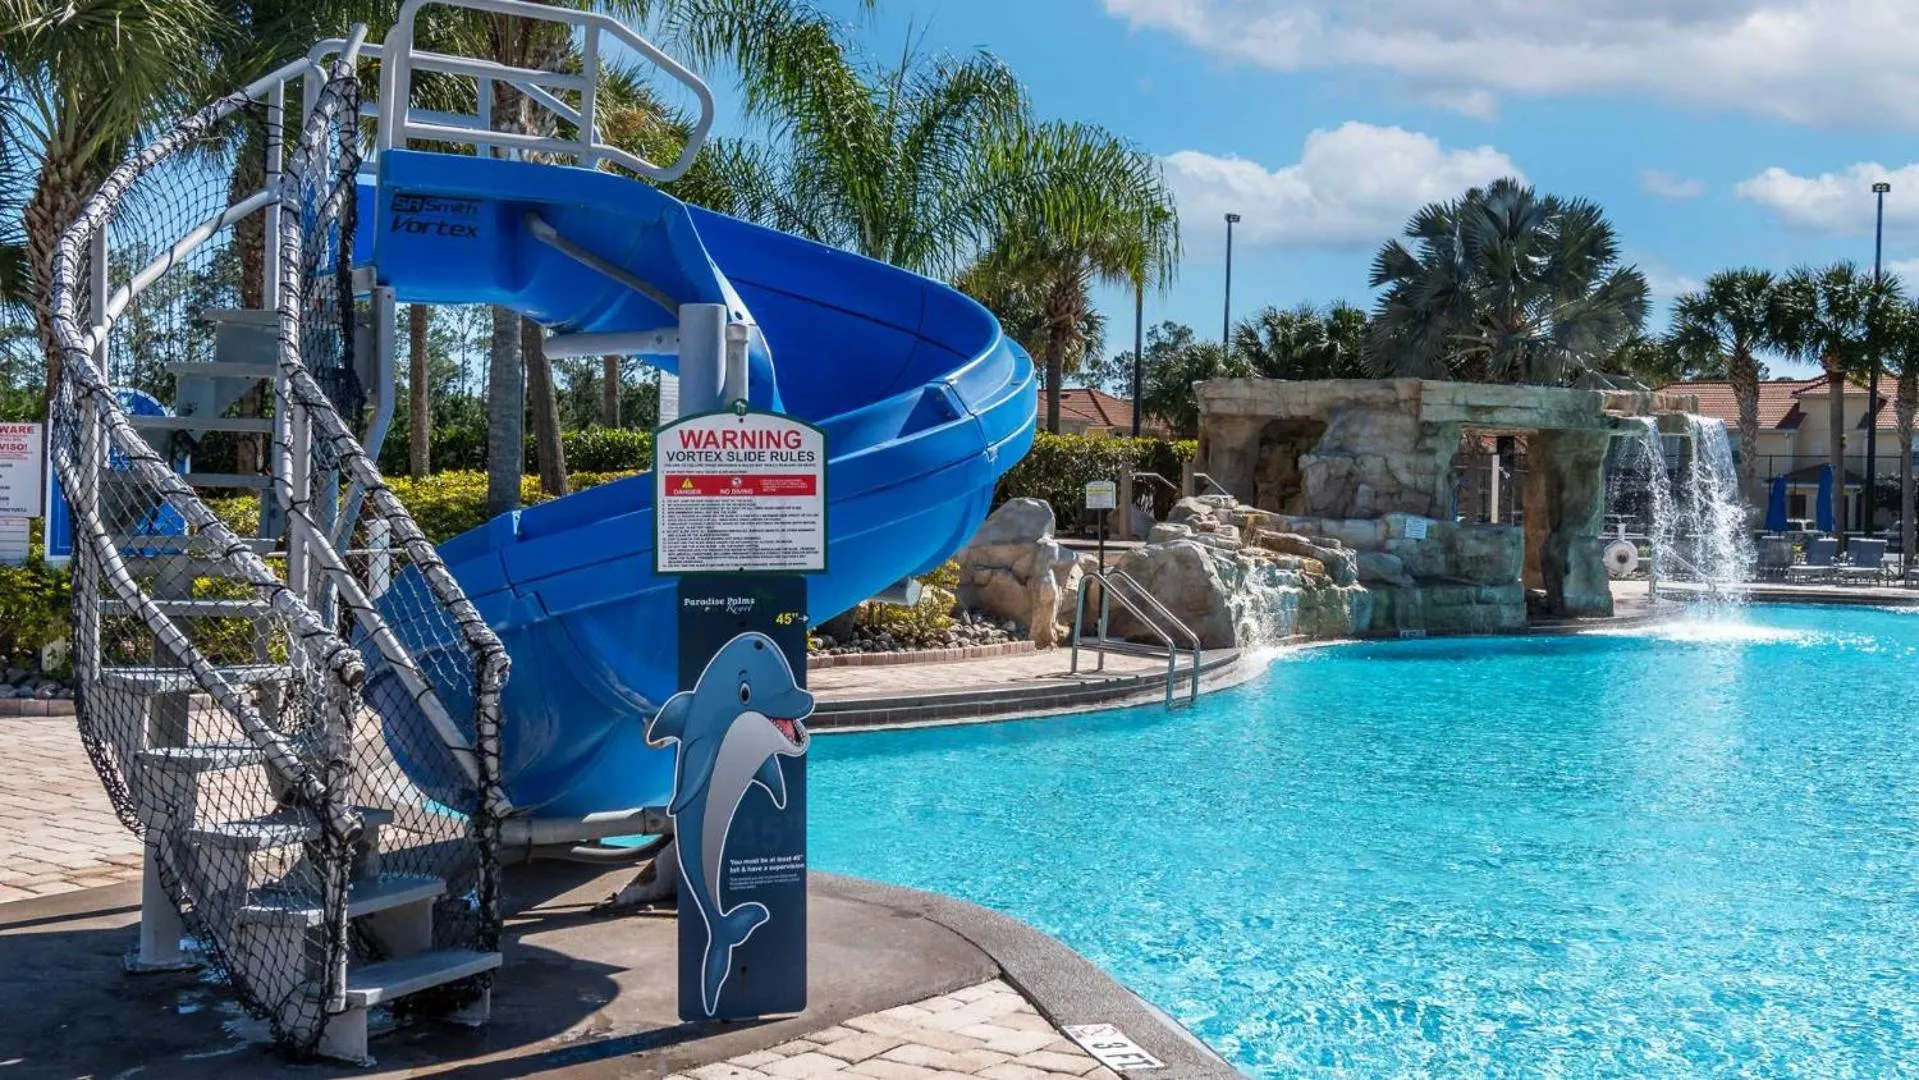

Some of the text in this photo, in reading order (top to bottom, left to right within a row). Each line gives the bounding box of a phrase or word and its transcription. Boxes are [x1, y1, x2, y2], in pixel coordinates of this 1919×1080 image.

[391, 214, 478, 239] Vortex
[679, 429, 802, 450] WARNING
[666, 450, 815, 463] VORTEX SLIDE RULES
[683, 597, 756, 606] Paradise Palms
[775, 612, 799, 625] 45"
[1092, 1042, 1156, 1068] 3 FT
